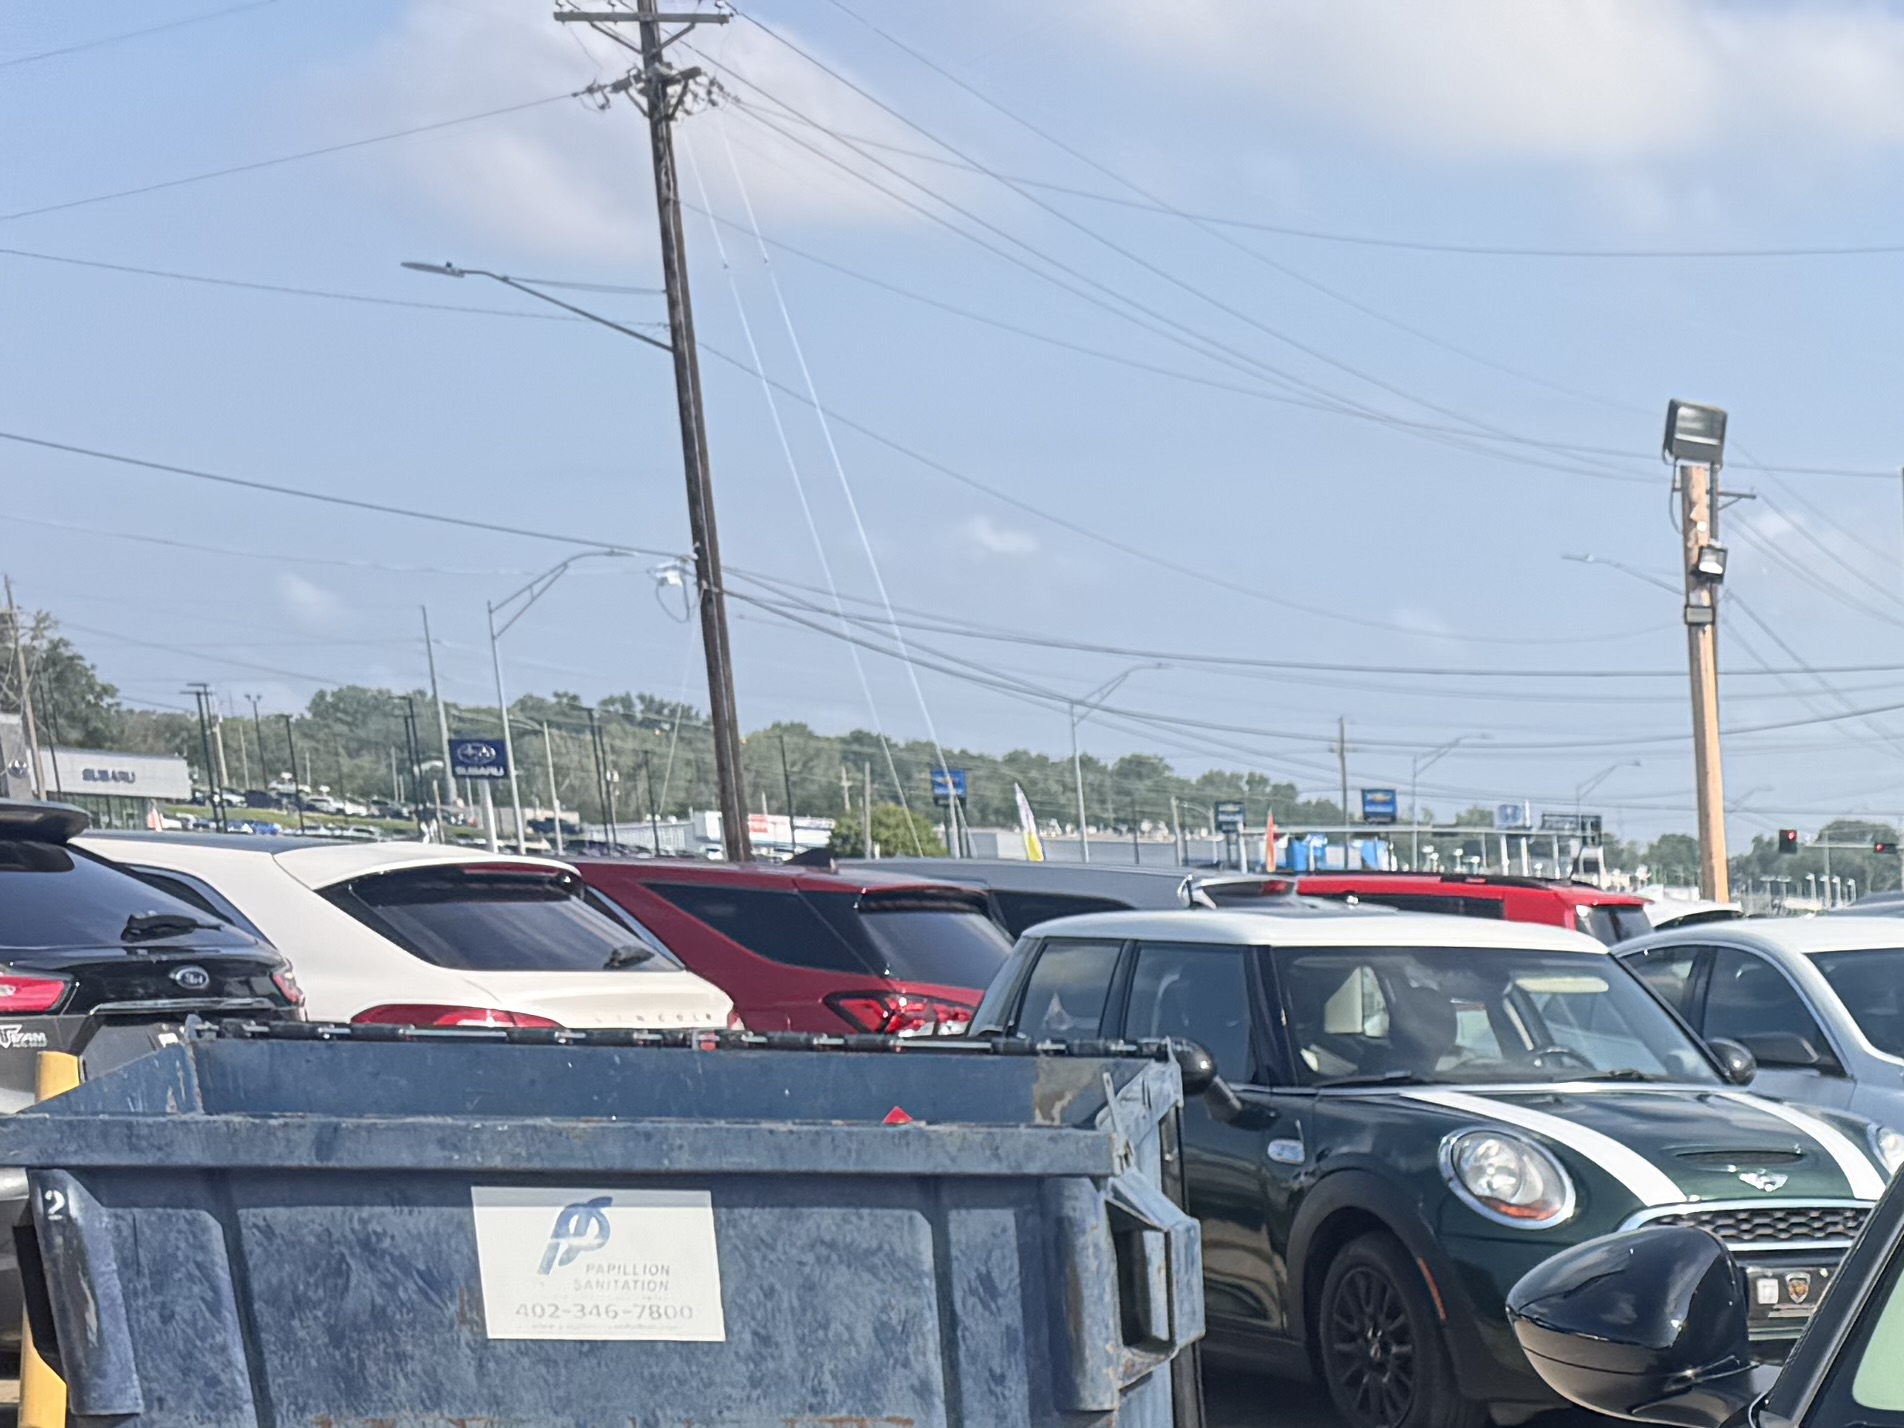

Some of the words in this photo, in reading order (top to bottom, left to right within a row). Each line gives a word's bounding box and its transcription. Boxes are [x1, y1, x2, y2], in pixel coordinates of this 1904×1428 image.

[82, 767, 136, 785] SUBARU
[44, 1189, 66, 1221] 2
[585, 1263, 671, 1277] PAPILLION
[574, 1278, 670, 1293] SANITATION
[514, 1303, 694, 1321] 402-346-7800
